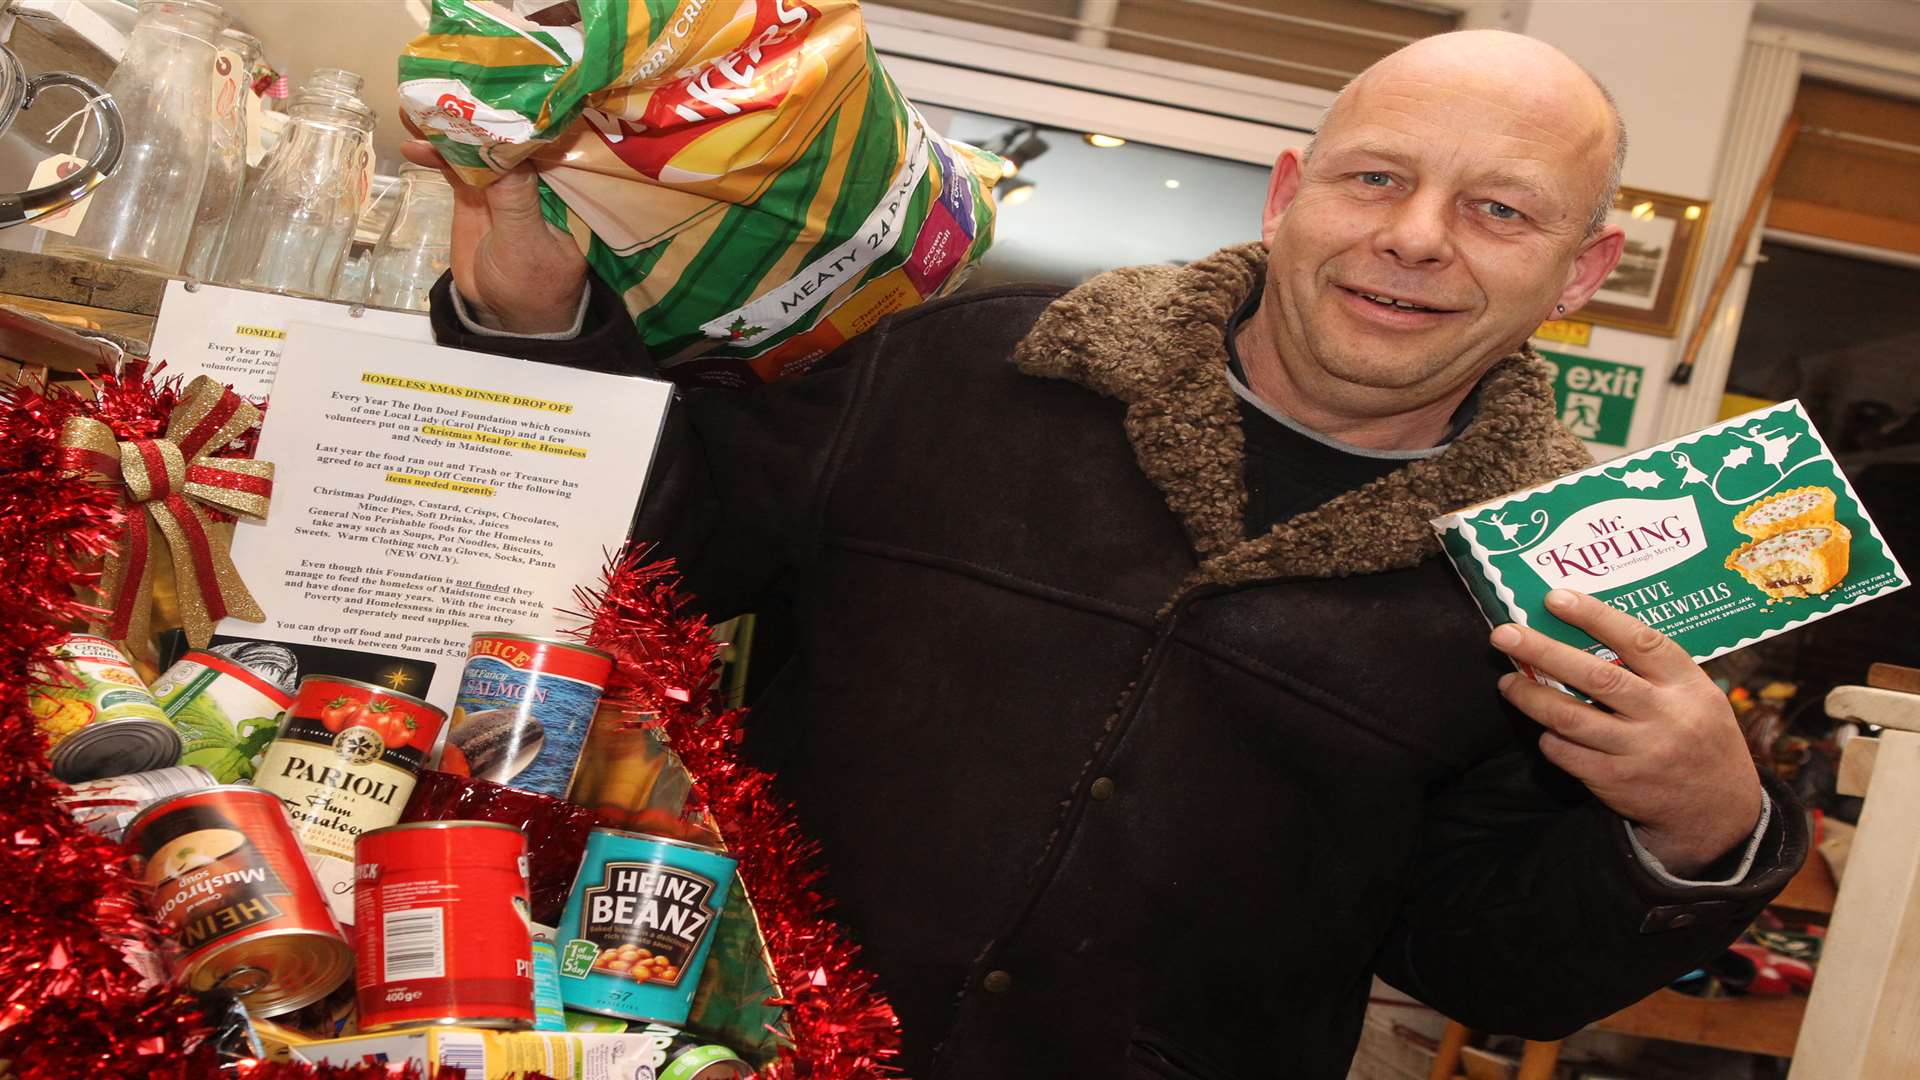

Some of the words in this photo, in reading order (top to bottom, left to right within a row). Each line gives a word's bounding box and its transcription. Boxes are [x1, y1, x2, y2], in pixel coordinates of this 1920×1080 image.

[781, 248, 858, 313] MEATY
[867, 219, 889, 249] 24
[888, 161, 916, 215] PACK
[922, 231, 943, 265] Prawn
[923, 229, 951, 276] Cocktail
[361, 373, 426, 390] HOMELESS
[428, 384, 463, 396] XMAS
[464, 389, 511, 404] DINNER
[512, 397, 546, 409] DROP
[548, 402, 572, 413] OFF
[1566, 366, 1637, 398] exit
[331, 390, 361, 403] Every
[363, 395, 388, 406] Year
[390, 399, 412, 410] The
[412, 403, 433, 413] Don
[435, 406, 458, 417] Doel
[460, 410, 517, 426] Foundation
[520, 419, 550, 431] which
[552, 424, 591, 437] consists
[350, 404, 362, 413] of
[363, 408, 381, 416] one
[383, 409, 411, 420] Local
[413, 414, 439, 426] Lady
[440, 418, 474, 431] (Carol
[476, 423, 515, 437] Pickup)
[517, 429, 536, 439] and
[548, 434, 564, 443] few
[325, 411, 376, 426] volunteers
[378, 419, 395, 430] put
[421, 425, 473, 440] Christmas
[474, 434, 502, 444] Meal
[501, 438, 518, 447] for
[520, 440, 536, 450] the
[538, 443, 586, 457] Homeless
[391, 431, 410, 441] and
[412, 435, 443, 448] Needy
[446, 440, 456, 448] in
[316, 442, 337, 452] Last
[339, 448, 364, 458] year
[365, 449, 381, 458] the
[383, 452, 405, 462] food
[407, 457, 424, 465] ran
[427, 458, 443, 468] out
[446, 461, 465, 471] and
[467, 464, 497, 475] Trash
[513, 471, 559, 485] Treasure
[561, 478, 578, 487] has
[316, 454, 351, 467] agreed
[353, 459, 364, 467] to
[365, 460, 381, 469] act
[404, 466, 430, 478] Drop
[433, 470, 451, 479] Off
[452, 472, 487, 484] Centre
[488, 478, 506, 487] for
[507, 480, 523, 490] the
[525, 483, 571, 498] following
[385, 473, 412, 484] items
[414, 477, 449, 489] needed
[313, 484, 365, 499] Christmas
[308, 505, 348, 518] General
[351, 511, 371, 521] Non
[374, 514, 426, 528] Perishable
[428, 521, 455, 532] foods
[457, 525, 473, 535] for
[475, 528, 491, 537] the
[493, 531, 541, 544] Homeless
[543, 538, 553, 546] to
[358, 502, 389, 513] Mince
[416, 510, 436, 519] Soft
[478, 518, 509, 529] Juices
[1587, 515, 1625, 539] Mr.
[384, 547, 416, 560] (NEW
[1536, 515, 1692, 578] KIPLING
[301, 558, 326, 568] Even
[327, 561, 363, 574] though
[365, 566, 384, 575] this
[385, 569, 443, 583] Foundation
[445, 576, 454, 584] is
[455, 578, 474, 587] not
[473, 580, 512, 592] funded
[512, 585, 534, 597] they
[342, 605, 398, 621] desperately
[401, 612, 425, 622] need
[1686, 614, 1699, 624] AND
[1700, 601, 1736, 618] RASPBERRY
[1696, 614, 1721, 628] FESTIVE
[1723, 602, 1757, 618] SPRINKLES
[467, 679, 550, 704] SALMON
[281, 756, 399, 806] PARIOLI
[155, 867, 266, 924] Mushroom
[180, 870, 209, 888] soup
[616, 869, 702, 906] HEINZ
[592, 895, 706, 942] BEANZ
[563, 958, 575, 972] 5
[571, 943, 578, 957] 1
[608, 991, 633, 1002] 57
